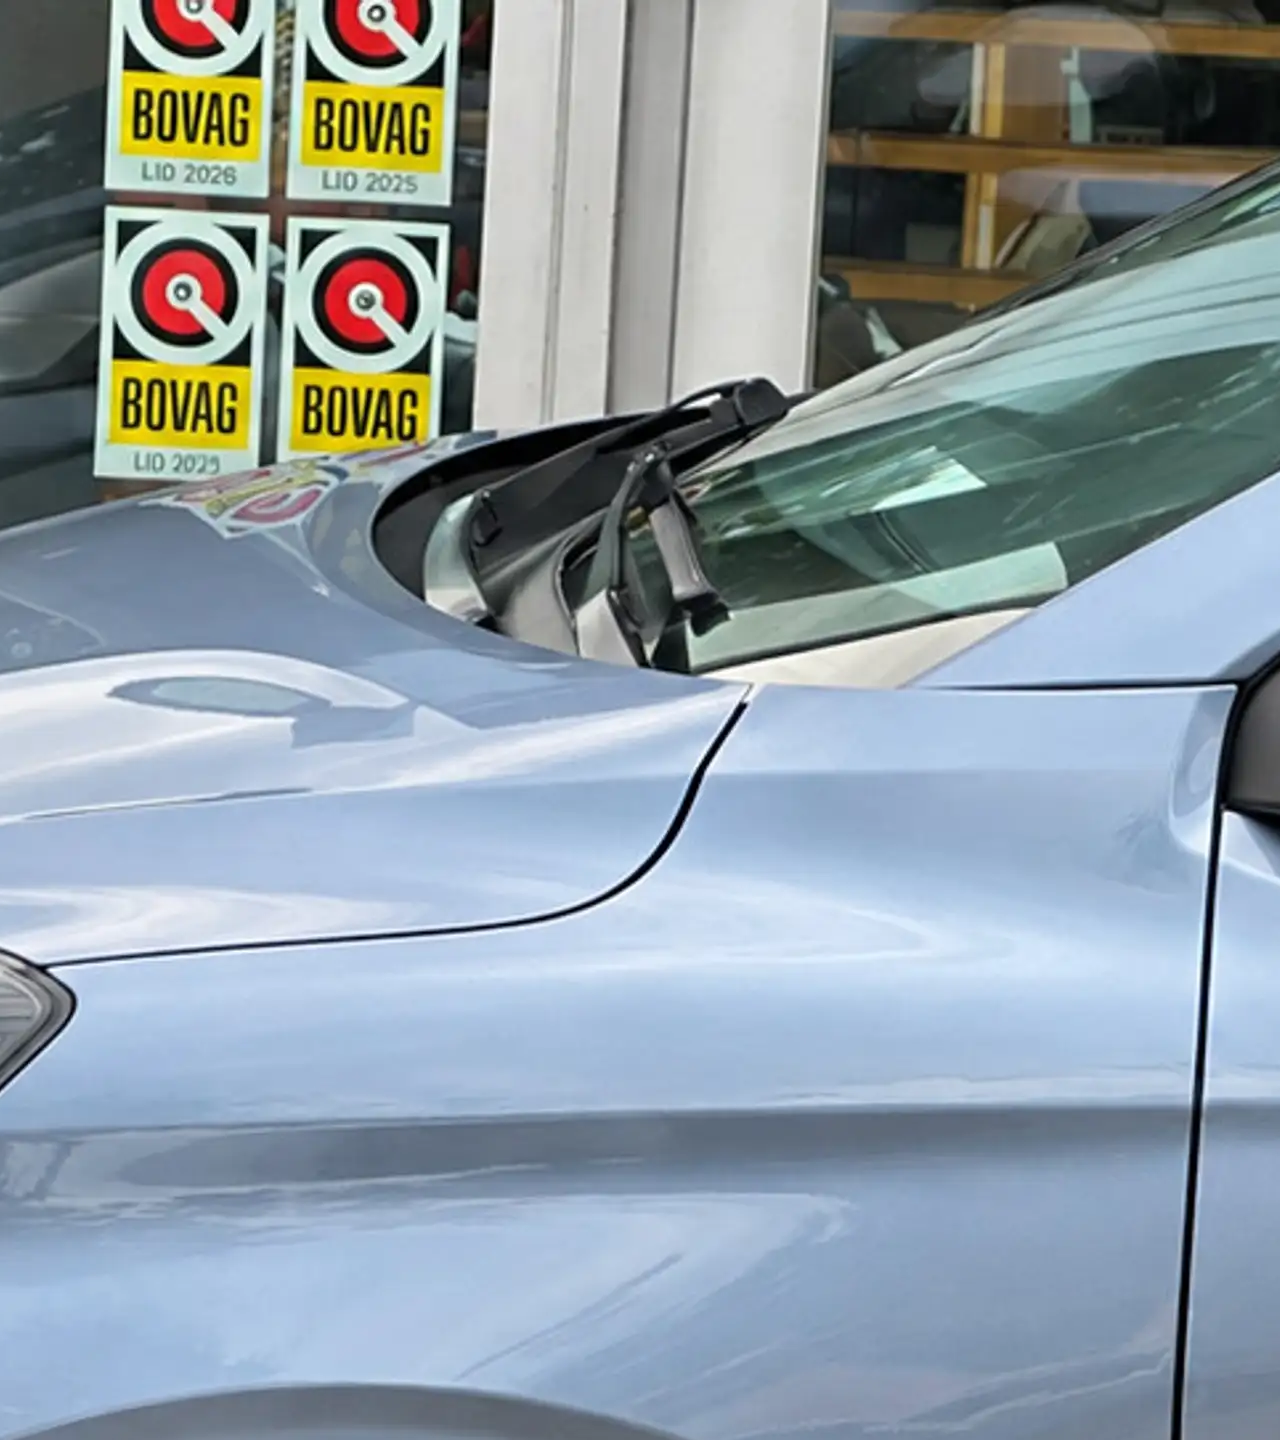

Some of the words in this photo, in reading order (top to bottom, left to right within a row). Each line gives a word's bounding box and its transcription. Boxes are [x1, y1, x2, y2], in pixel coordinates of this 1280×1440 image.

[133, 88, 250, 147] BOVAG
[314, 97, 431, 156] BOVAG
[141, 162, 176, 182] LID
[183, 164, 237, 186] 2026
[321, 170, 358, 191] LID
[365, 172, 418, 194] 2025
[122, 377, 238, 434] BOVAG
[303, 384, 418, 441] BOVAG
[134, 452, 166, 473] LID
